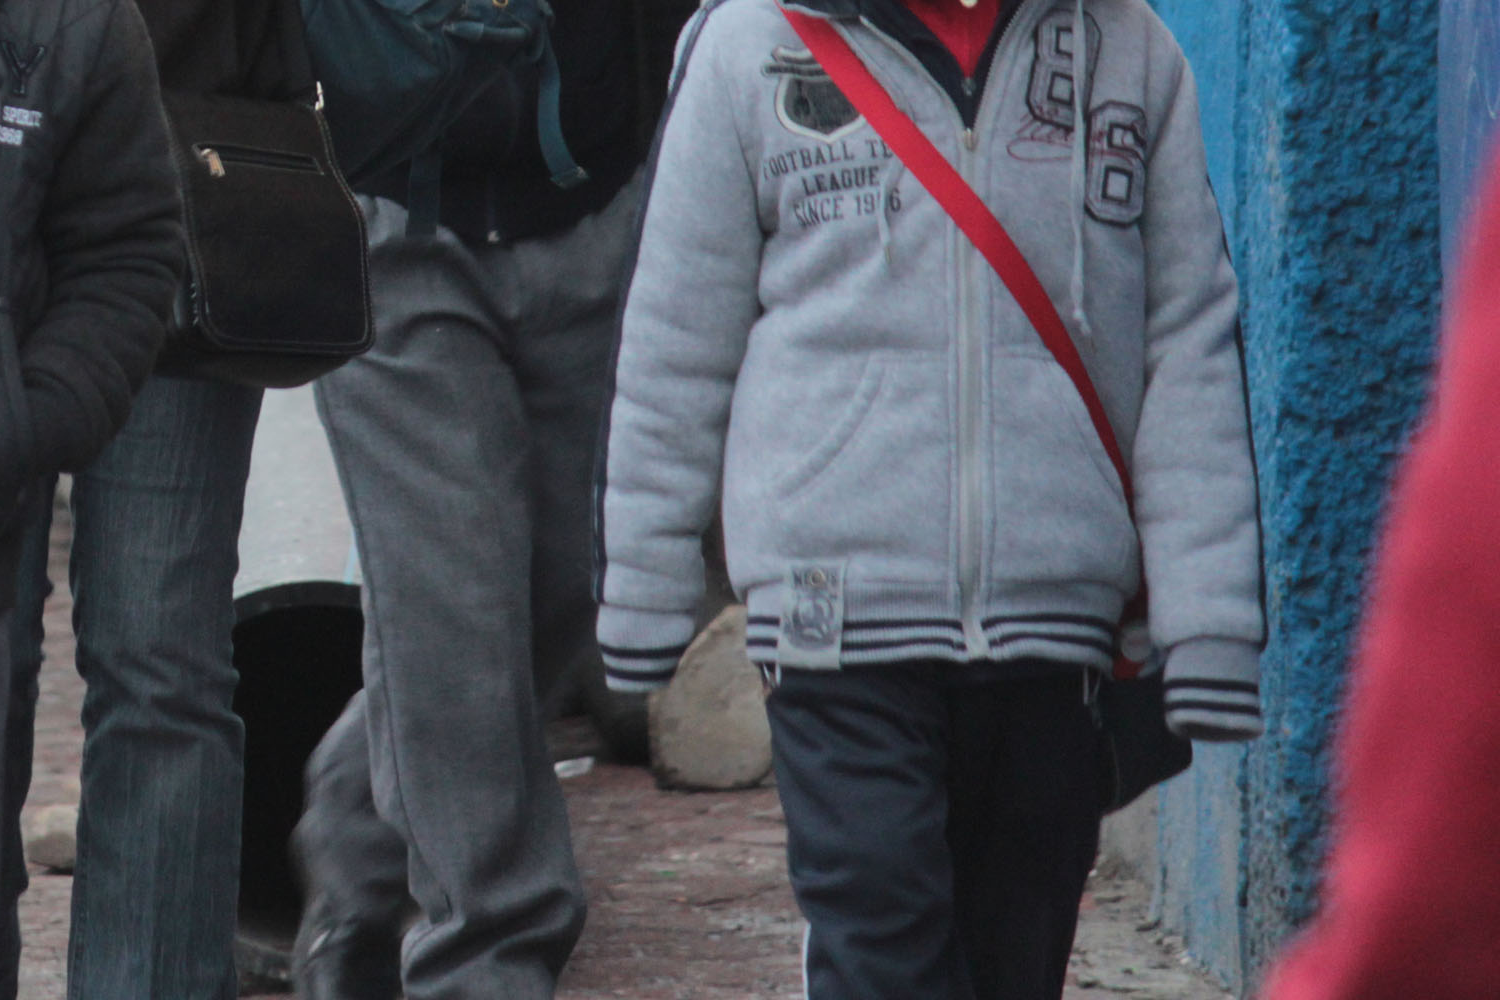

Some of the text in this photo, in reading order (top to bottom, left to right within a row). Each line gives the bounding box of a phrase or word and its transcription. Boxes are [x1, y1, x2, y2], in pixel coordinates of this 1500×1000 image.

[801, 165, 881, 197] LEAGUE
[793, 186, 902, 229] SINCE 196
